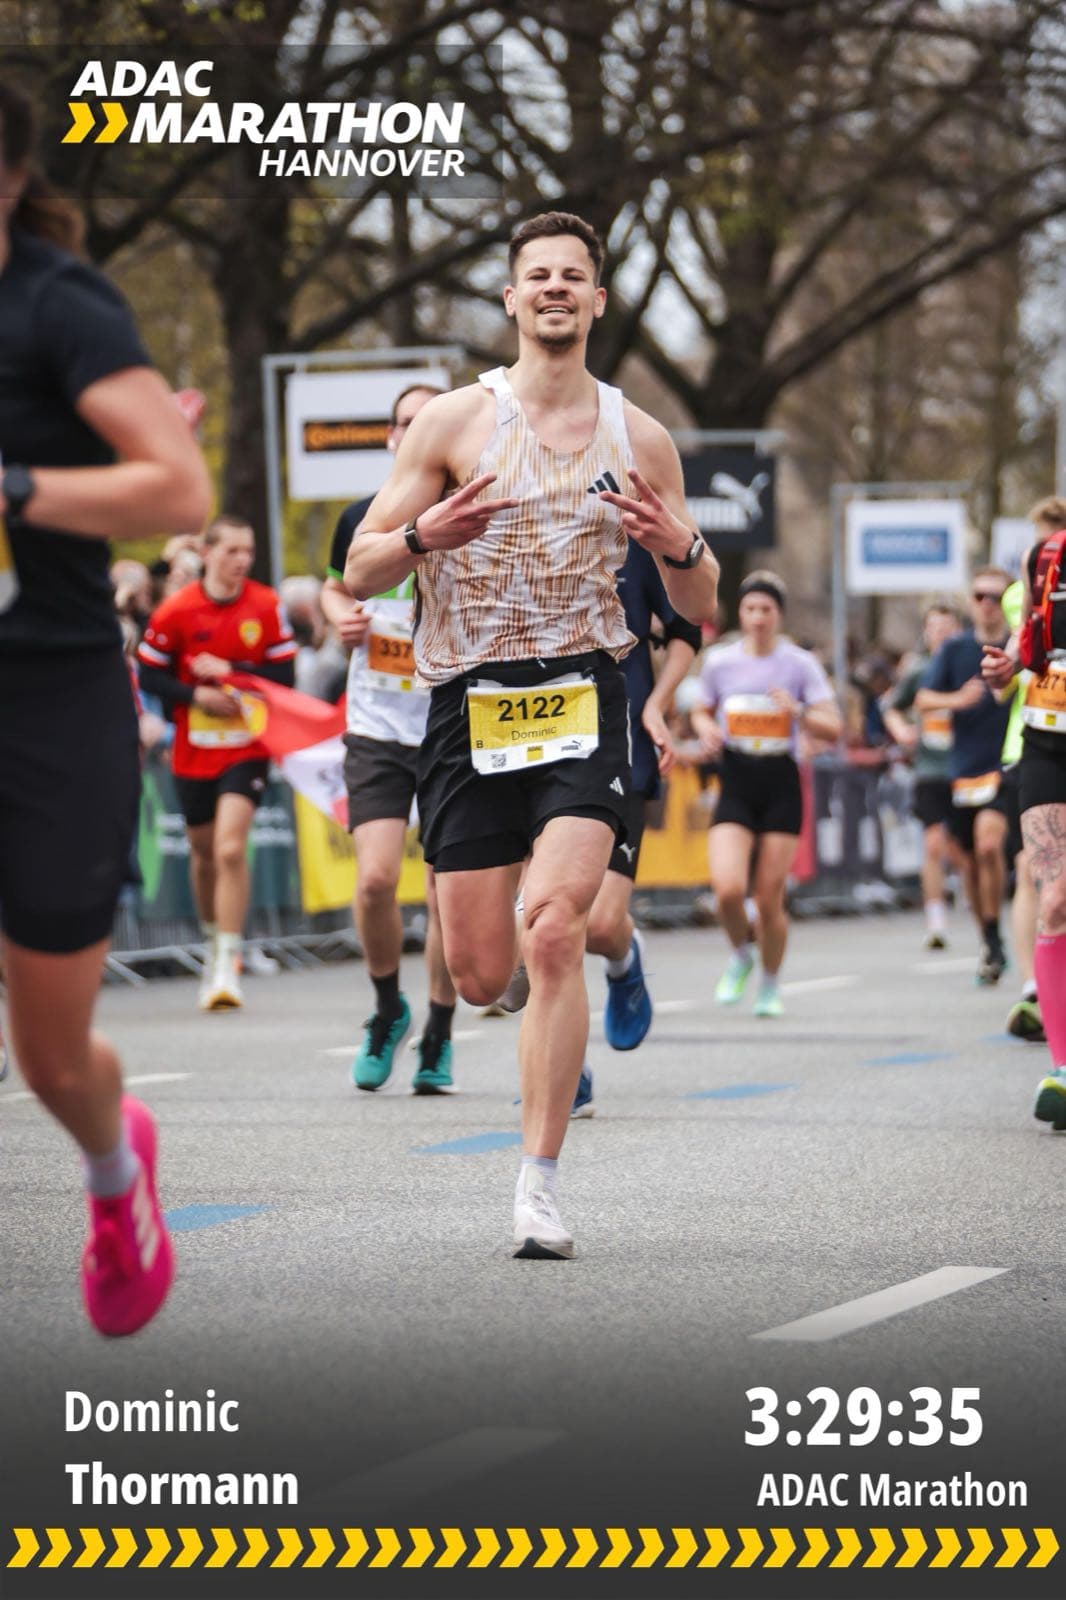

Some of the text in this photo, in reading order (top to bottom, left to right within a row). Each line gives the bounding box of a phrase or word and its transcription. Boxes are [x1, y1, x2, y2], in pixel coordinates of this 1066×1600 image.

[380, 638, 413, 658] 337
[497, 694, 566, 722] 2122
[511, 725, 558, 741] Dominic
[475, 739, 484, 749] B
